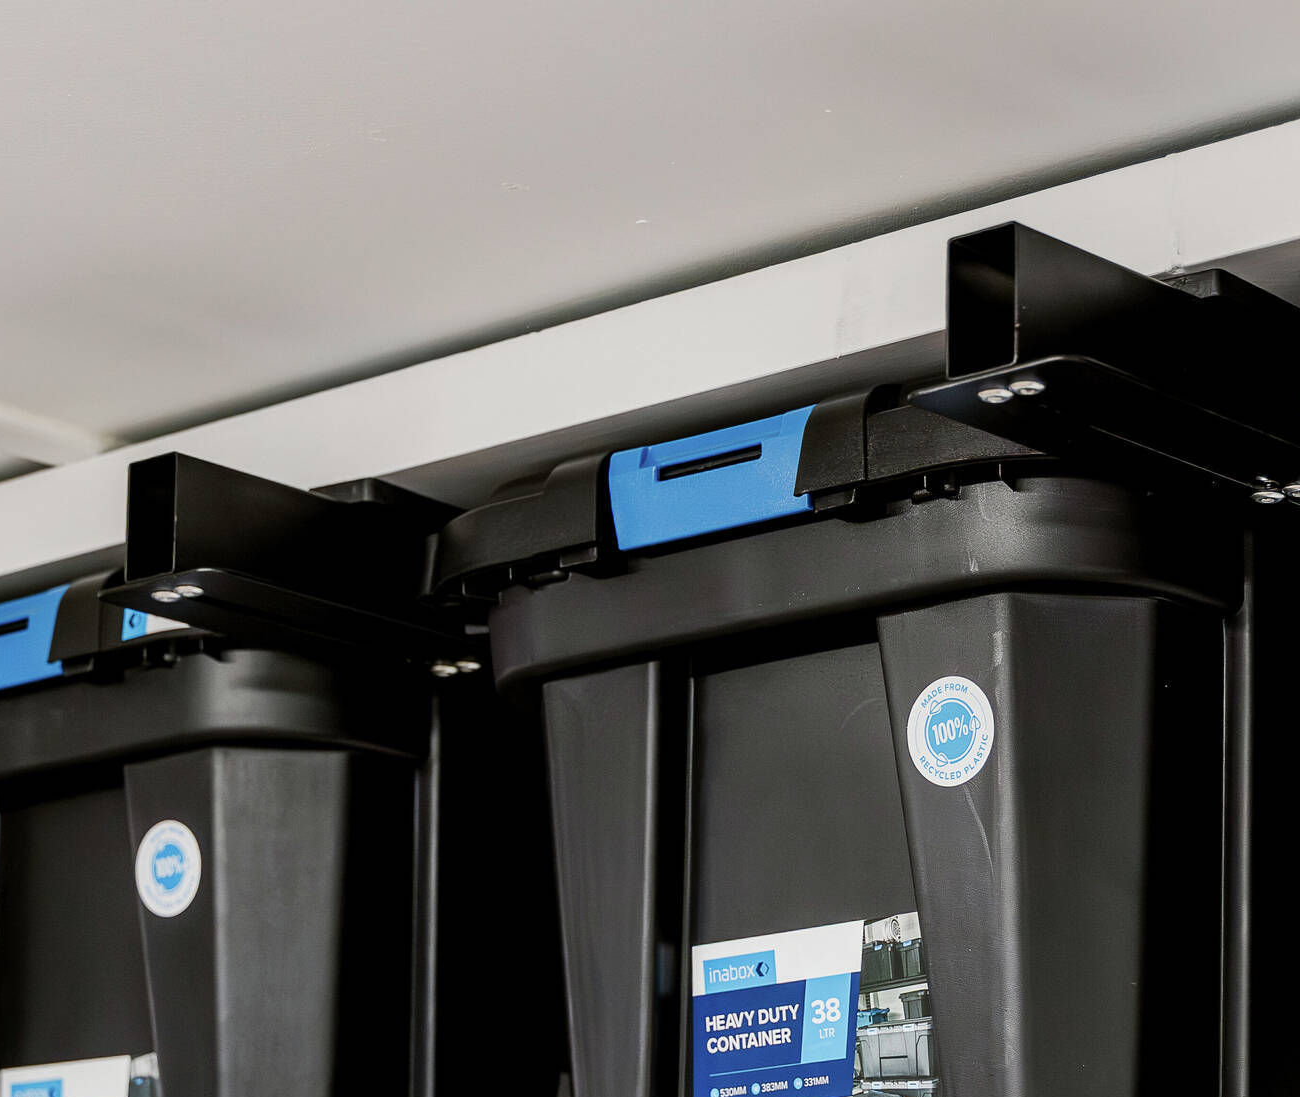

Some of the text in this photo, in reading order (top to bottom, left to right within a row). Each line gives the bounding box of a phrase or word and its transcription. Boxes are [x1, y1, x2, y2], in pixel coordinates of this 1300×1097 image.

[921, 683, 969, 708] MADE FROM
[932, 715, 969, 746] 100%
[919, 733, 989, 780] RECYCLED PLASTIC
[709, 963, 755, 984] inabox
[705, 1003, 800, 1033] HEAVY DUTY
[811, 997, 841, 1025] 38
[706, 1027, 792, 1054] CONTAINER
[819, 1027, 835, 1040] LTR
[720, 1075, 829, 1097] 530MM 383MM 331MM
